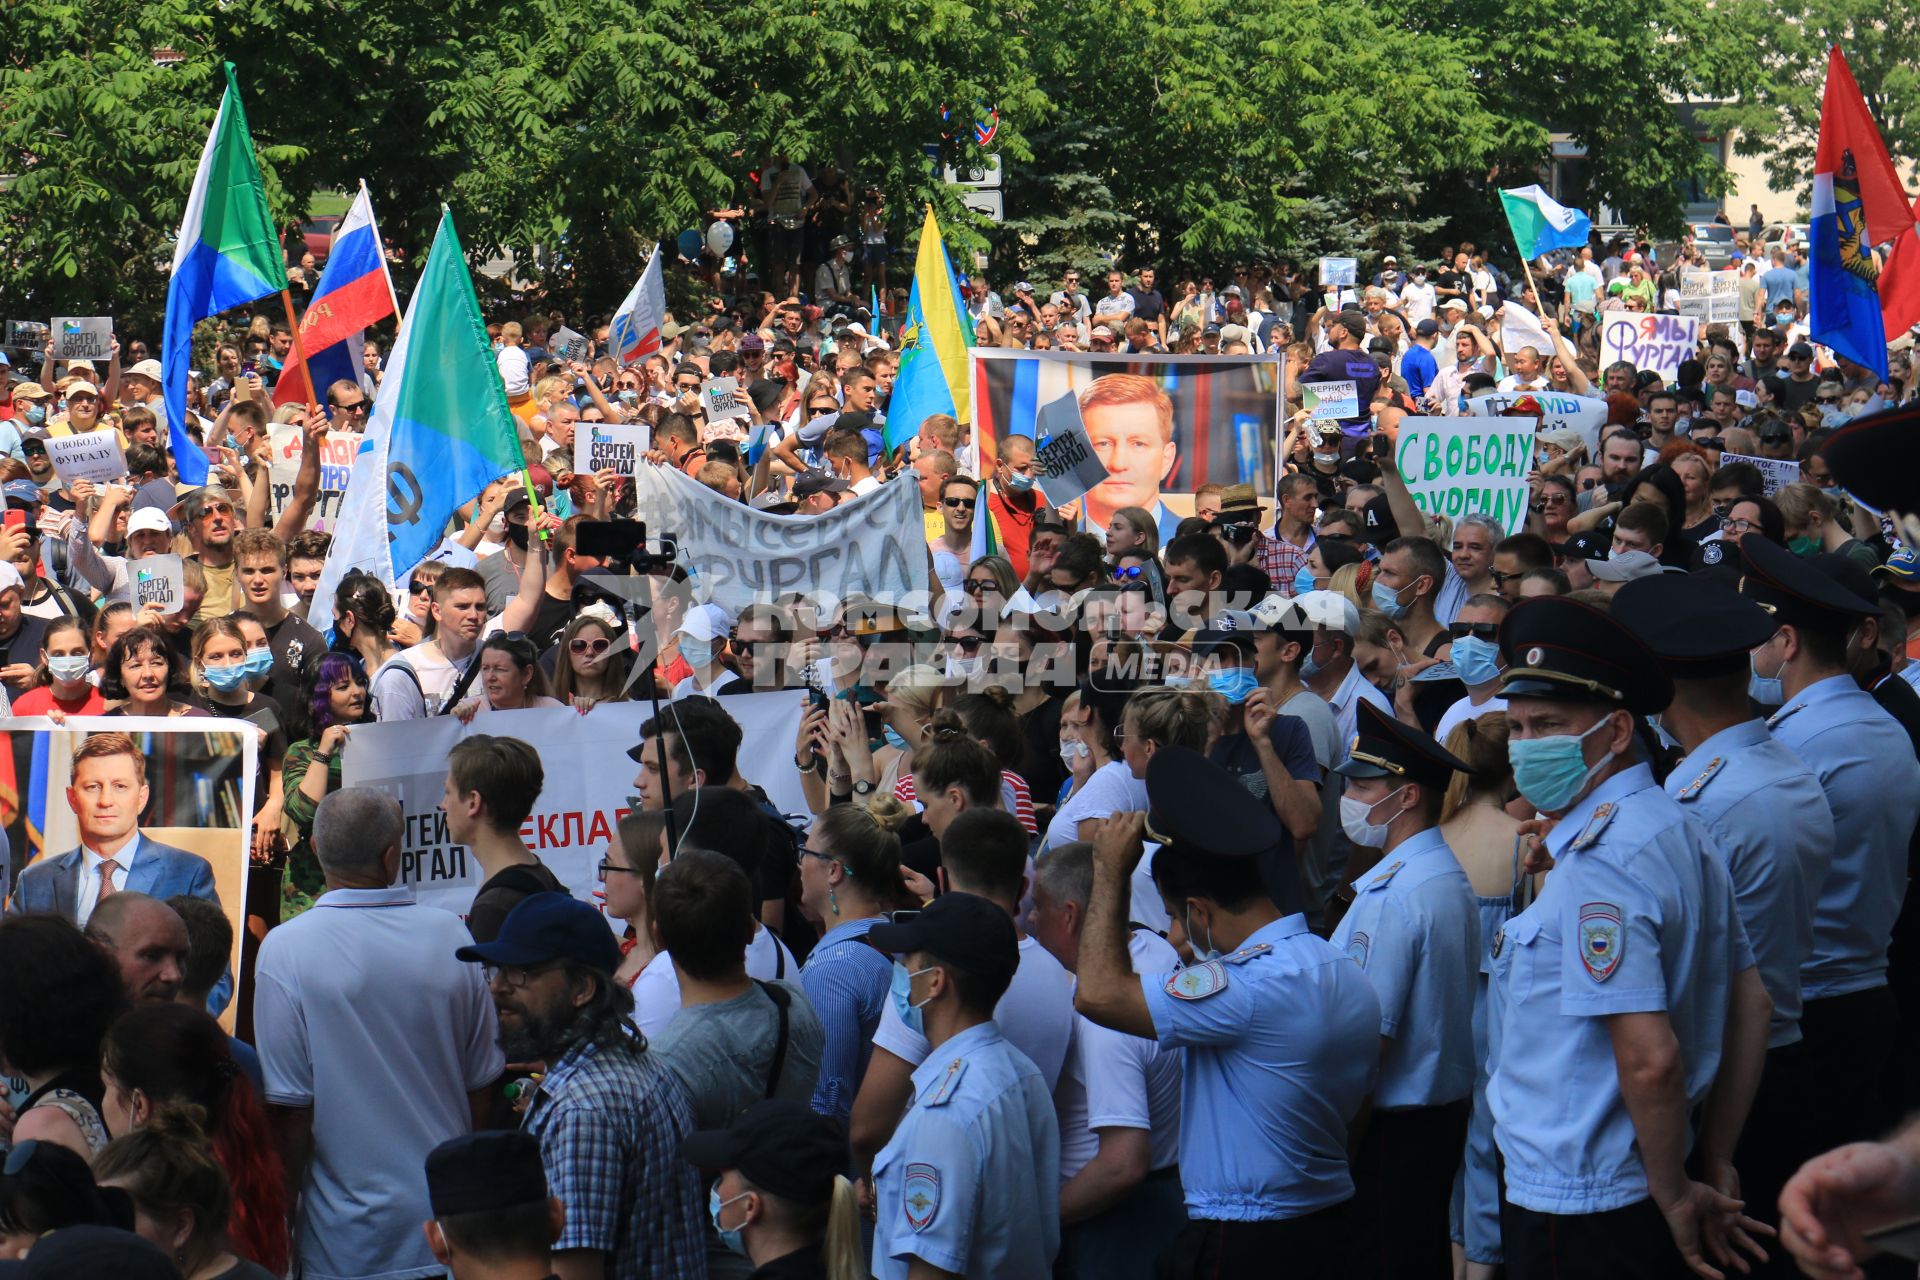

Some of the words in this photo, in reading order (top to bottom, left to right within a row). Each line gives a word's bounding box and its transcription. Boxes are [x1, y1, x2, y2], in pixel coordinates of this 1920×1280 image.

[63, 331, 98, 345] СЕРГЕЙ
[63, 345, 101, 357] ФУРГАЛ
[1317, 407, 1348, 415] ГОЛОС
[55, 436, 104, 451] СВОБОДУ
[591, 441, 635, 460] СЕРГЕЙ
[1037, 429, 1077, 466] СЕРГЕЙ
[55, 449, 112, 465] ФУРГАЛУ
[1047, 443, 1088, 479] ФУРГАЛ
[1398, 432, 1533, 485] СВОБОДУ
[138, 576, 169, 594] СЕРГЕЙ
[139, 590, 173, 606] ФУРГАЛ
